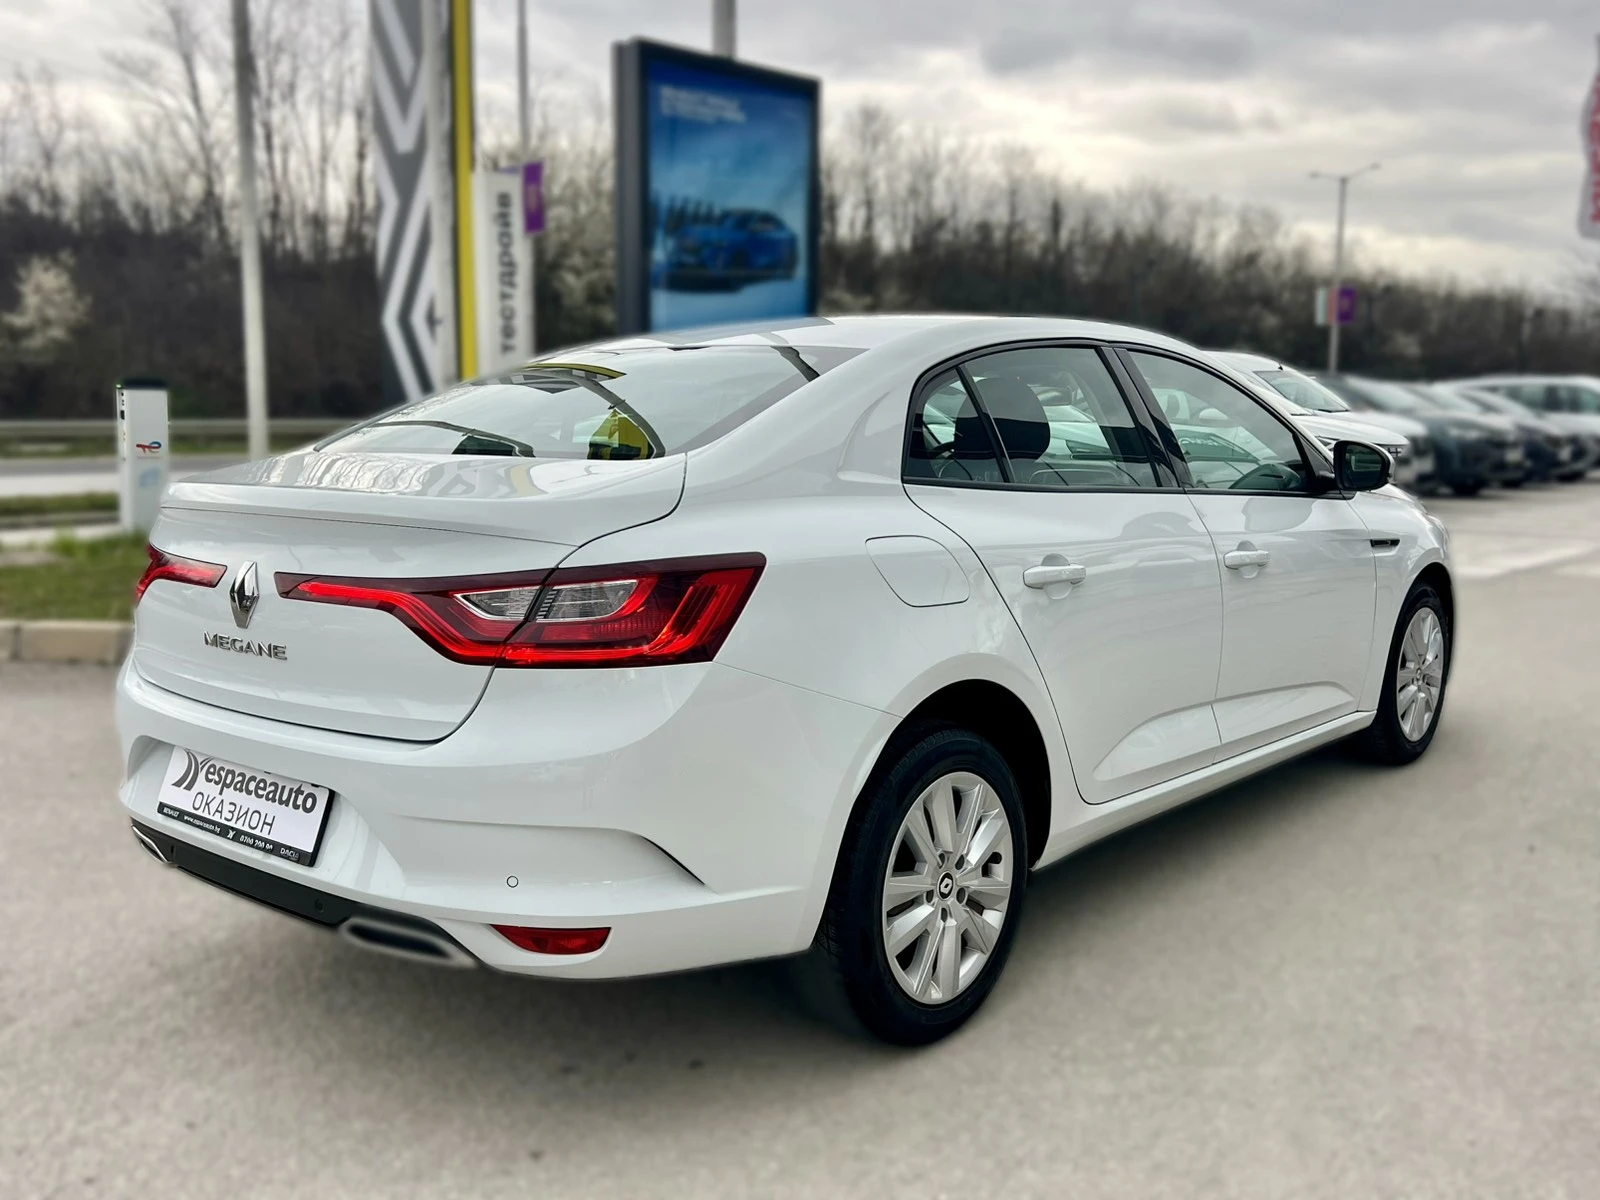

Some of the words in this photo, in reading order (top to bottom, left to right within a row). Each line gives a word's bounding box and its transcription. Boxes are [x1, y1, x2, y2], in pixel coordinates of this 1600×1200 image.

[203, 630, 288, 661] MEGANE
[204, 762, 318, 814] espaceauto
[191, 791, 276, 836] ОКАЗИОН
